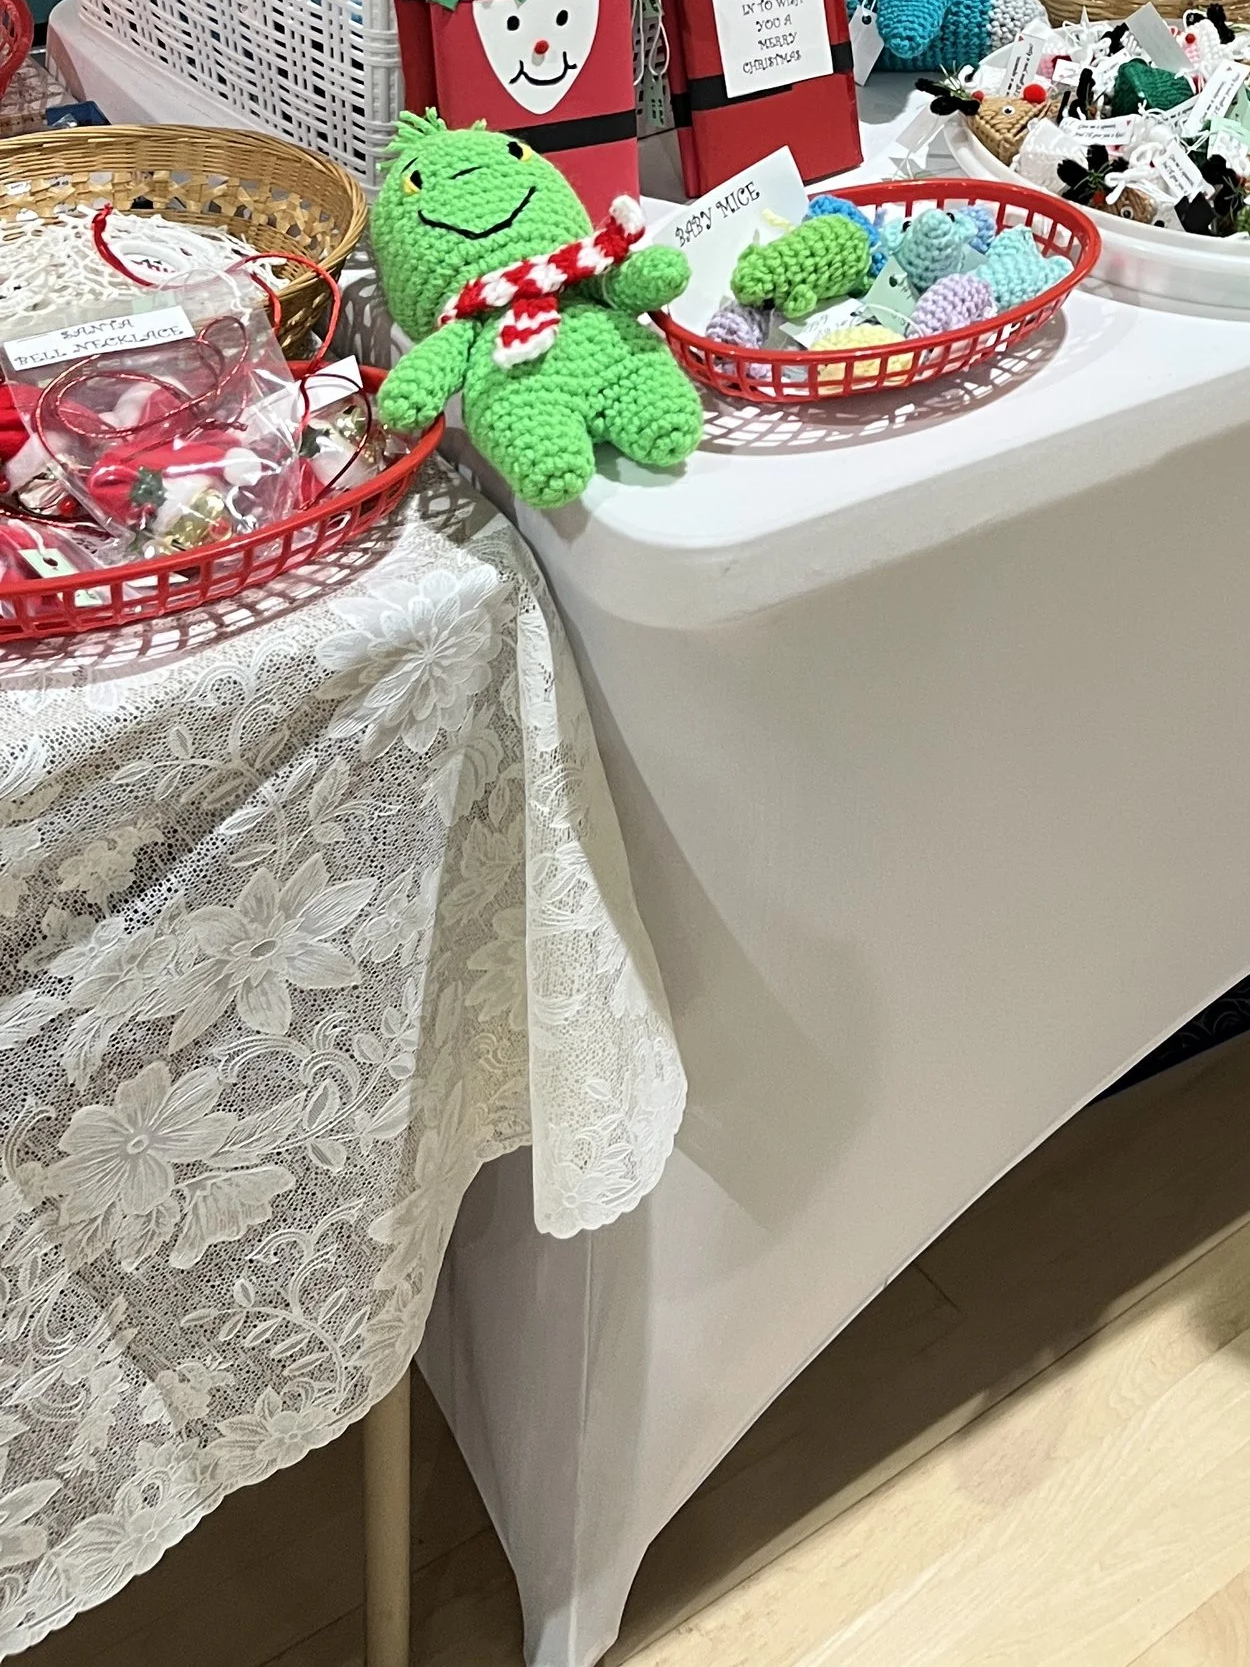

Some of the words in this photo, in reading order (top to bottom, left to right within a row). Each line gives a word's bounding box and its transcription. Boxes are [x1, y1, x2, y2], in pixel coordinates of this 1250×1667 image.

[742, 2, 756, 15] IN
[757, 0, 773, 12] TO
[755, 17, 781, 32] YOU
[783, 13, 792, 25] A
[758, 32, 797, 50] MERRY
[742, 49, 802, 74] CHRISTMAS
[674, 206, 713, 248] BABY
[715, 181, 761, 219] MICE
[60, 318, 134, 340] SANTA
[14, 347, 67, 367] BELL
[73, 325, 185, 353] NECKLACE
